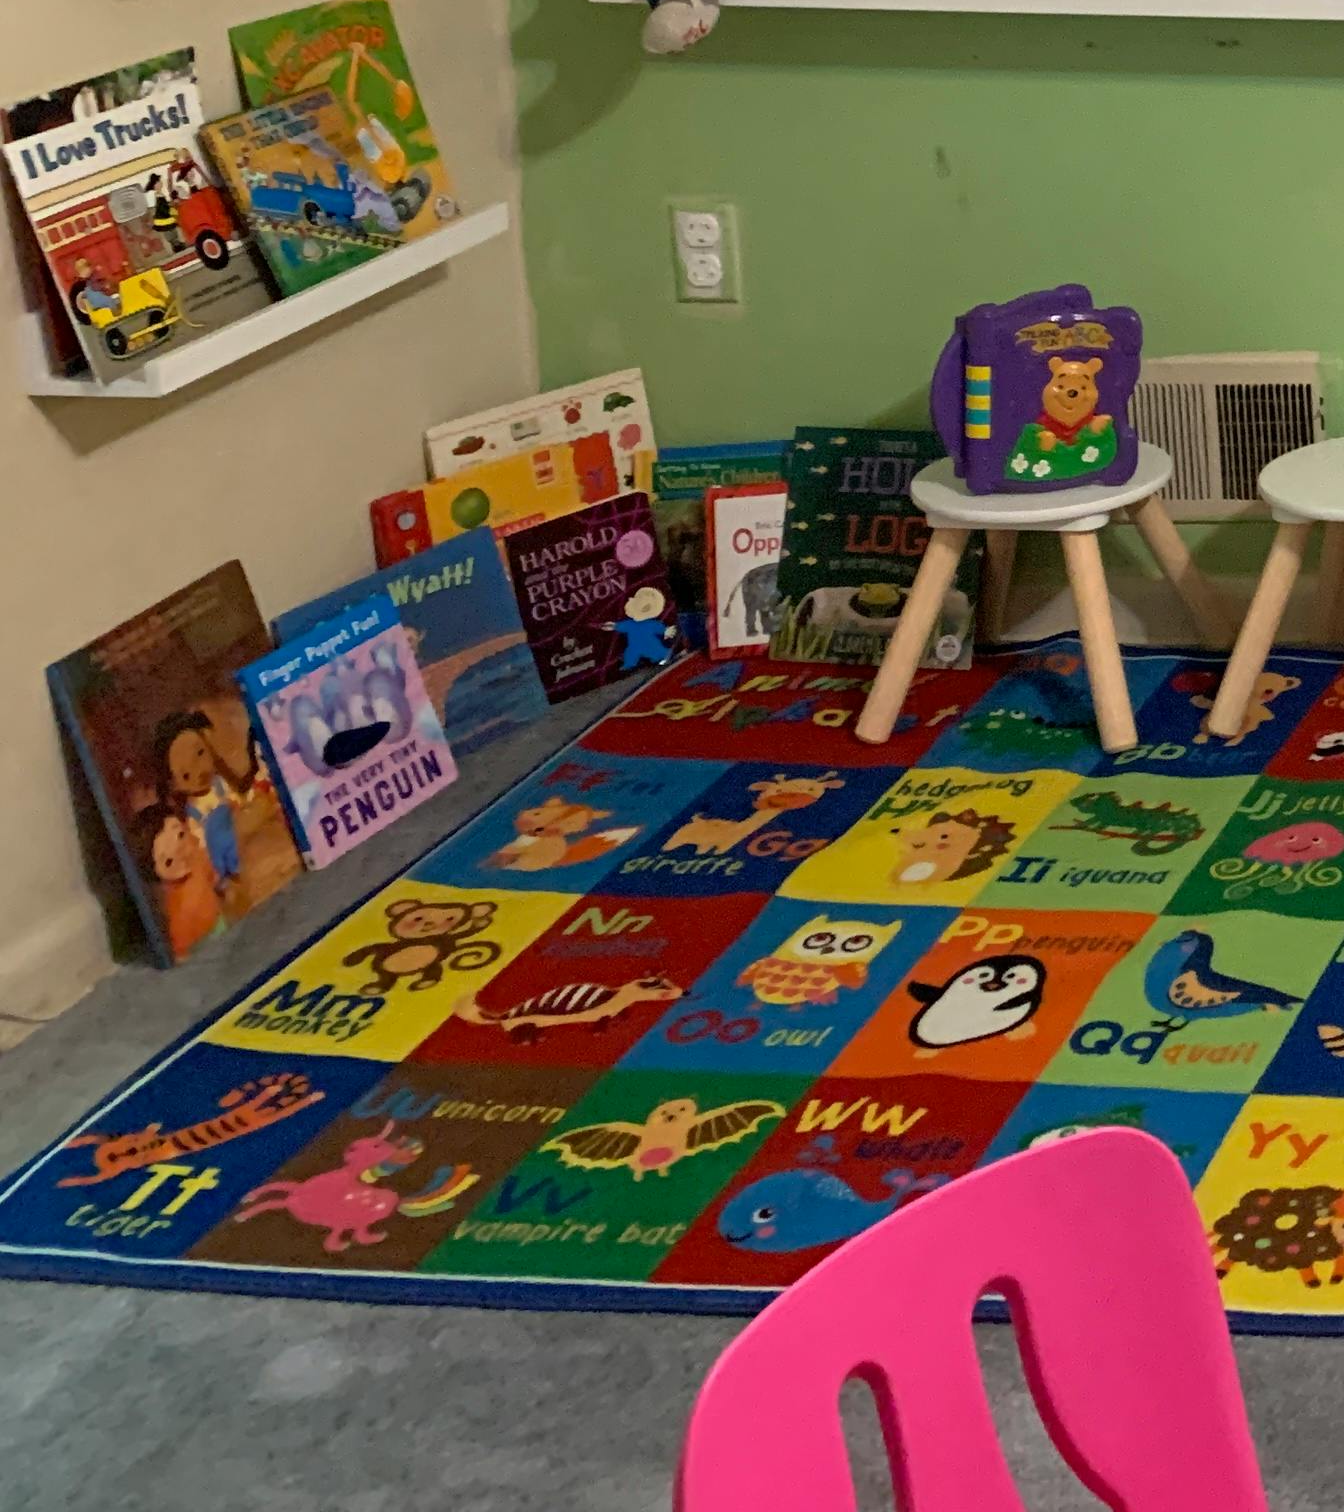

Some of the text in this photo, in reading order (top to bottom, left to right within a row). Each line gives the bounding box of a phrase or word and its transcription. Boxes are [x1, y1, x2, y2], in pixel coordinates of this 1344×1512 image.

[19, 92, 191, 180] I Love Trucks!
[518, 525, 619, 574] HAROLD
[732, 527, 783, 557] Opp
[386, 555, 475, 608] Wyatt!
[525, 557, 619, 605] PURPLE
[530, 573, 628, 623] CRAYON
[303, 628, 351, 663] Puppet
[318, 748, 443, 849] PENGUIN
[323, 781, 351, 806] THE
[351, 758, 385, 788] VERY
[1237, 788, 1290, 820] Jj
[619, 854, 745, 876] giraffe
[996, 855, 1168, 888] Ii iguana
[560, 906, 654, 937] Nn
[940, 914, 1136, 956] Pp penguin
[255, 979, 389, 1022] Mm
[231, 1010, 376, 1045] monkey
[664, 1008, 835, 1048] Oo owl
[1067, 1020, 1261, 1068] Qq quail
[430, 1096, 569, 1126] unicorn
[795, 1095, 929, 1138] Ww
[1246, 1119, 1331, 1170] Yy
[124, 1162, 220, 1218] Tt
[64, 1201, 176, 1241] tiger
[453, 1216, 692, 1248] vampire bat
